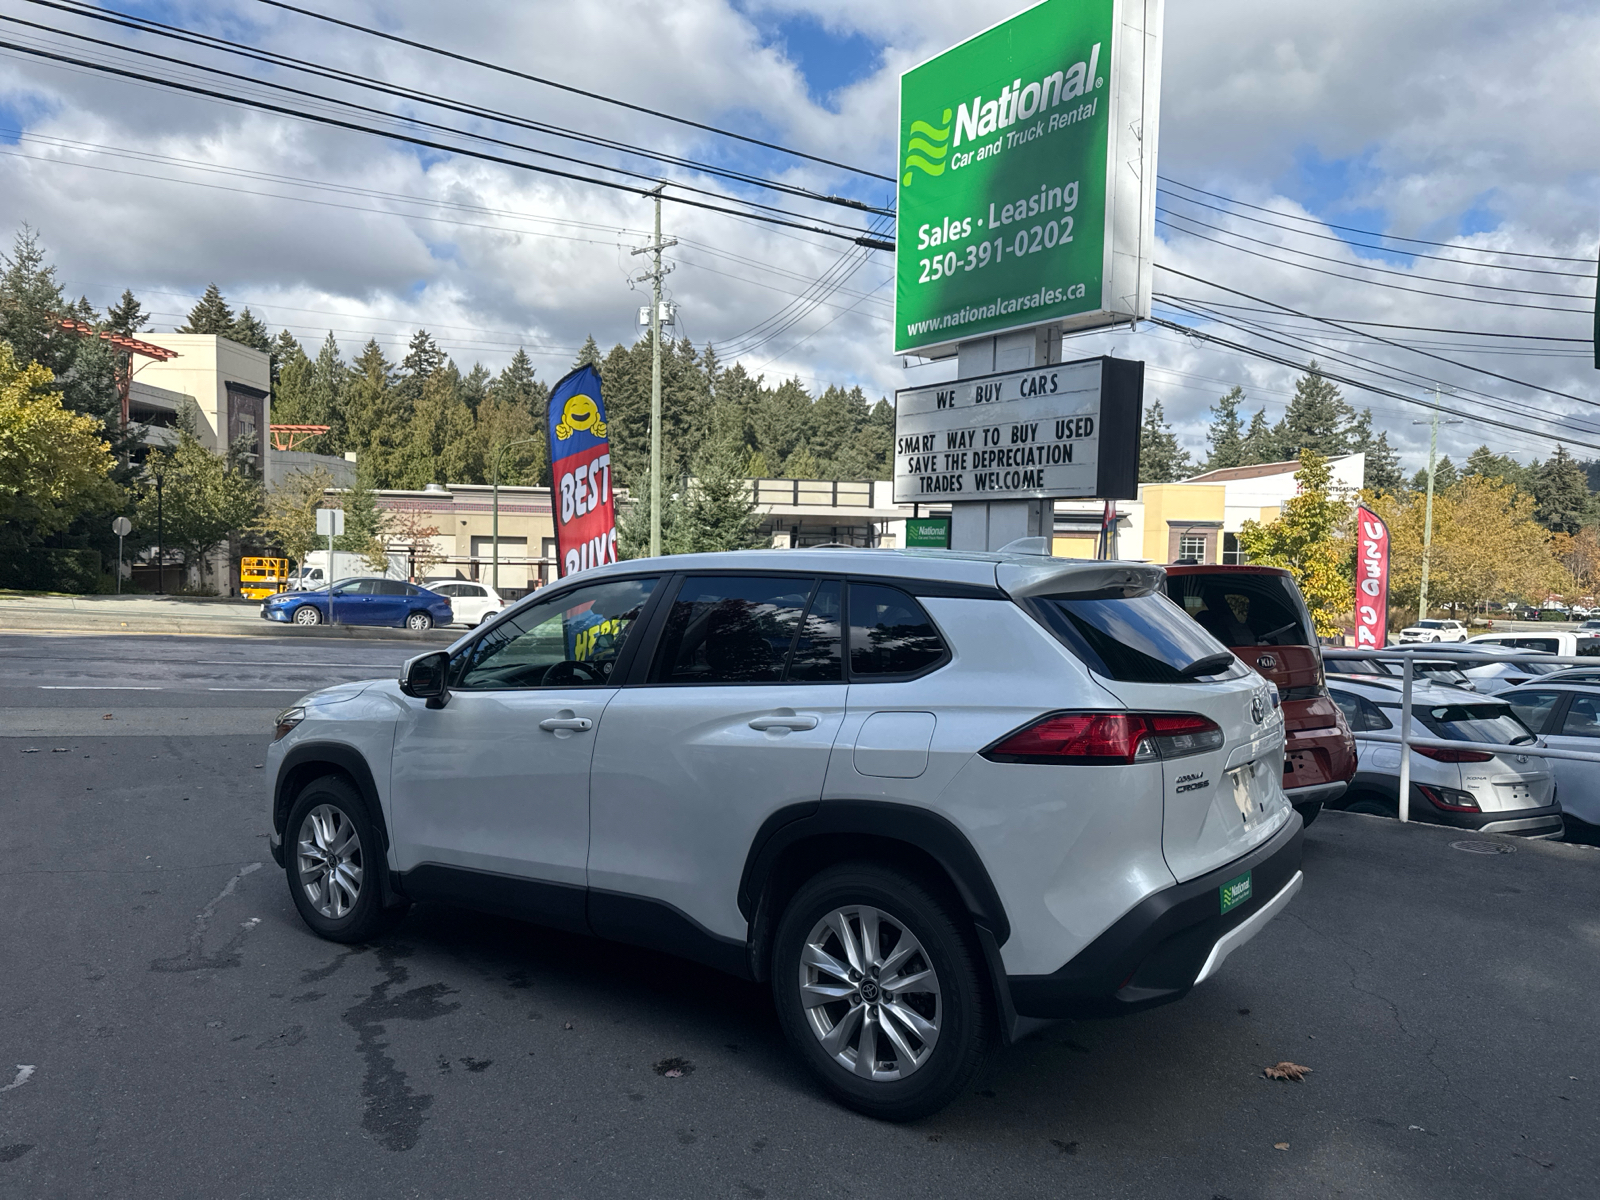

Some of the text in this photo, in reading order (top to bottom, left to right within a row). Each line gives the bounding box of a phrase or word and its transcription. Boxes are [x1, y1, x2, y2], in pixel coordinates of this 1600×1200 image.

[953, 42, 1101, 147] National
[951, 97, 1098, 170] Car and Truck Rental
[917, 181, 1079, 250] Sales Leasing
[918, 216, 1074, 284] 250-391-0202
[907, 283, 1086, 336] www.nationalcarsales.ca
[936, 374, 1058, 409] WE BUY CARS
[898, 417, 1094, 454] SMART WAY TO BUY USED
[908, 444, 1073, 473] SAVE THE DEPRECIATION
[560, 454, 610, 524] BEST
[919, 469, 1044, 493] TRADES WELCOME
[918, 525, 946, 536] National
[1175, 779, 1210, 794] CROSS
[1231, 876, 1251, 899] National
